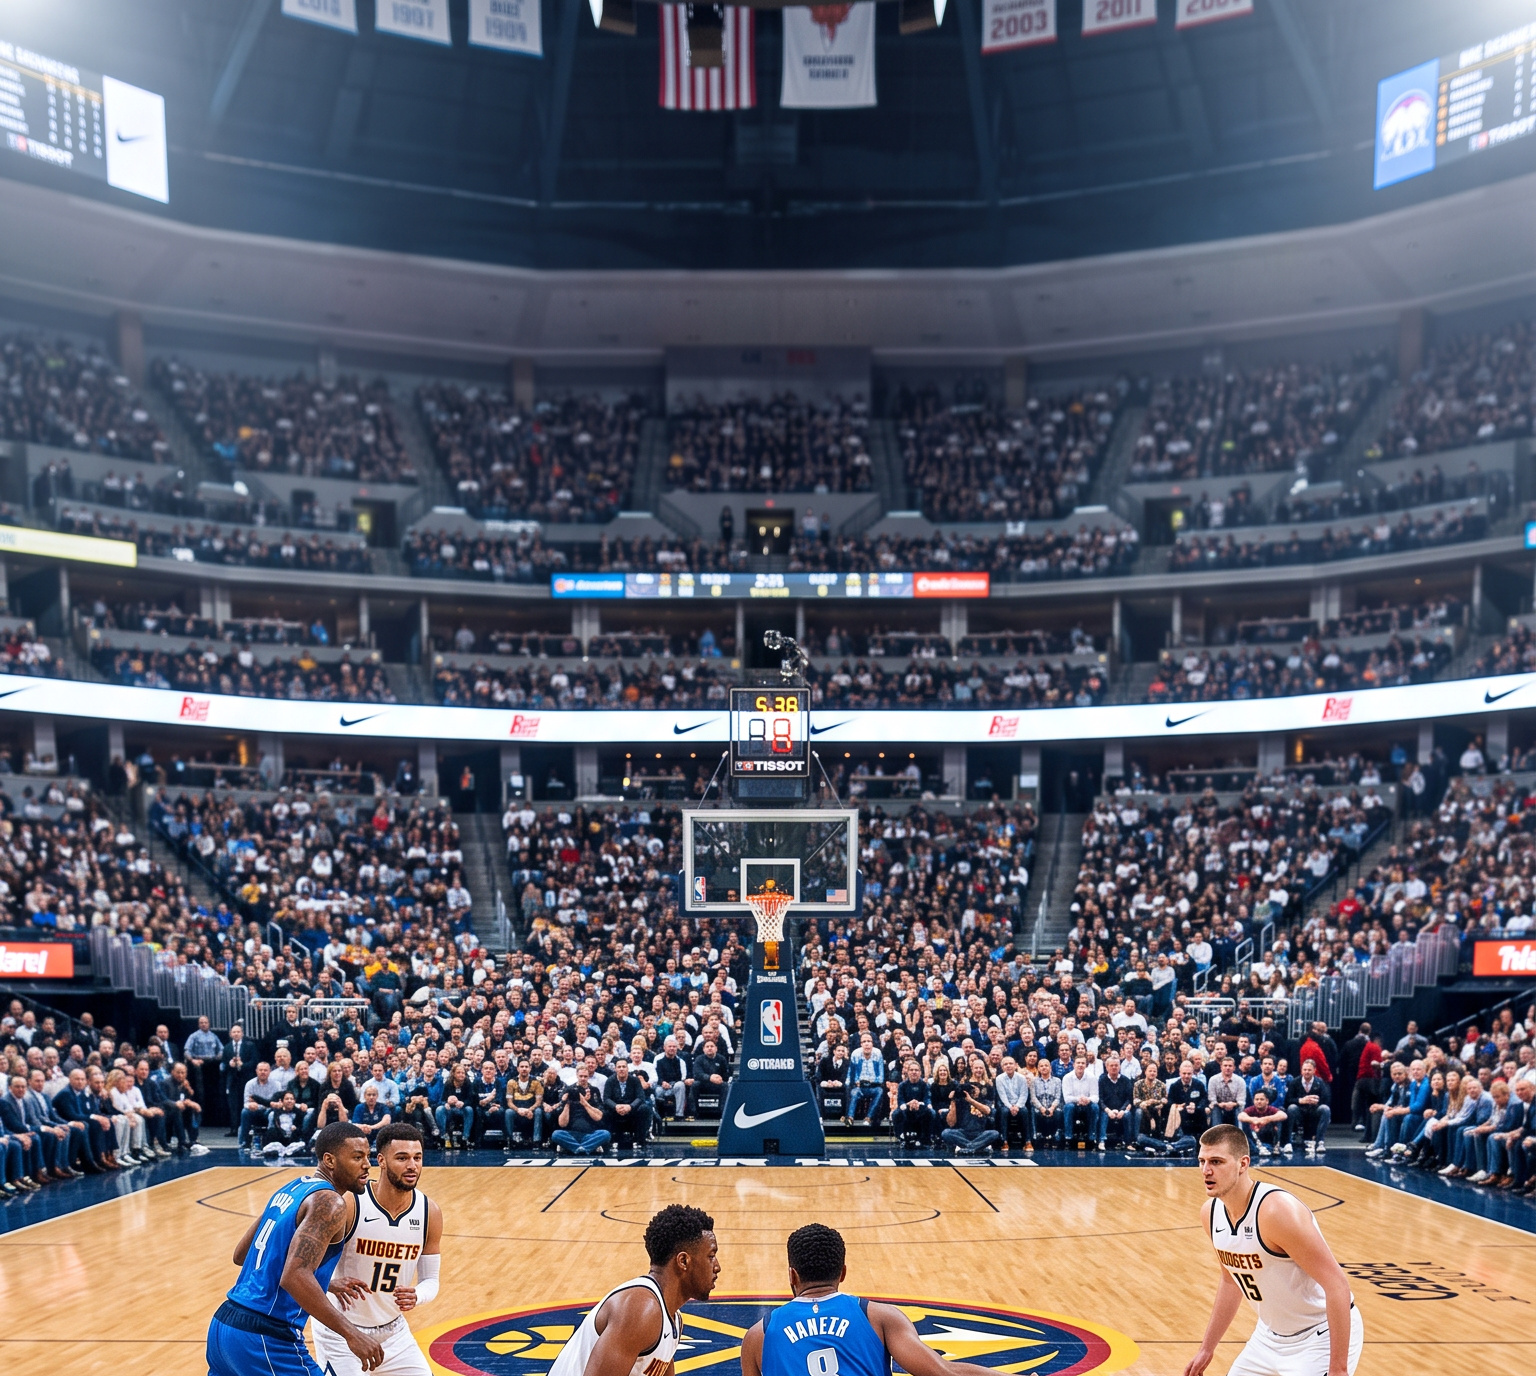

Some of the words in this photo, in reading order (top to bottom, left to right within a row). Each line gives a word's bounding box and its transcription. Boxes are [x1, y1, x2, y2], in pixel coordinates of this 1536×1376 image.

[990, 9, 1048, 40] 2003
[754, 761, 805, 771] TISSOT
[356, 1238, 420, 1260] NUGGETS
[370, 1261, 401, 1293] 15
[1233, 1272, 1263, 1301] 15
